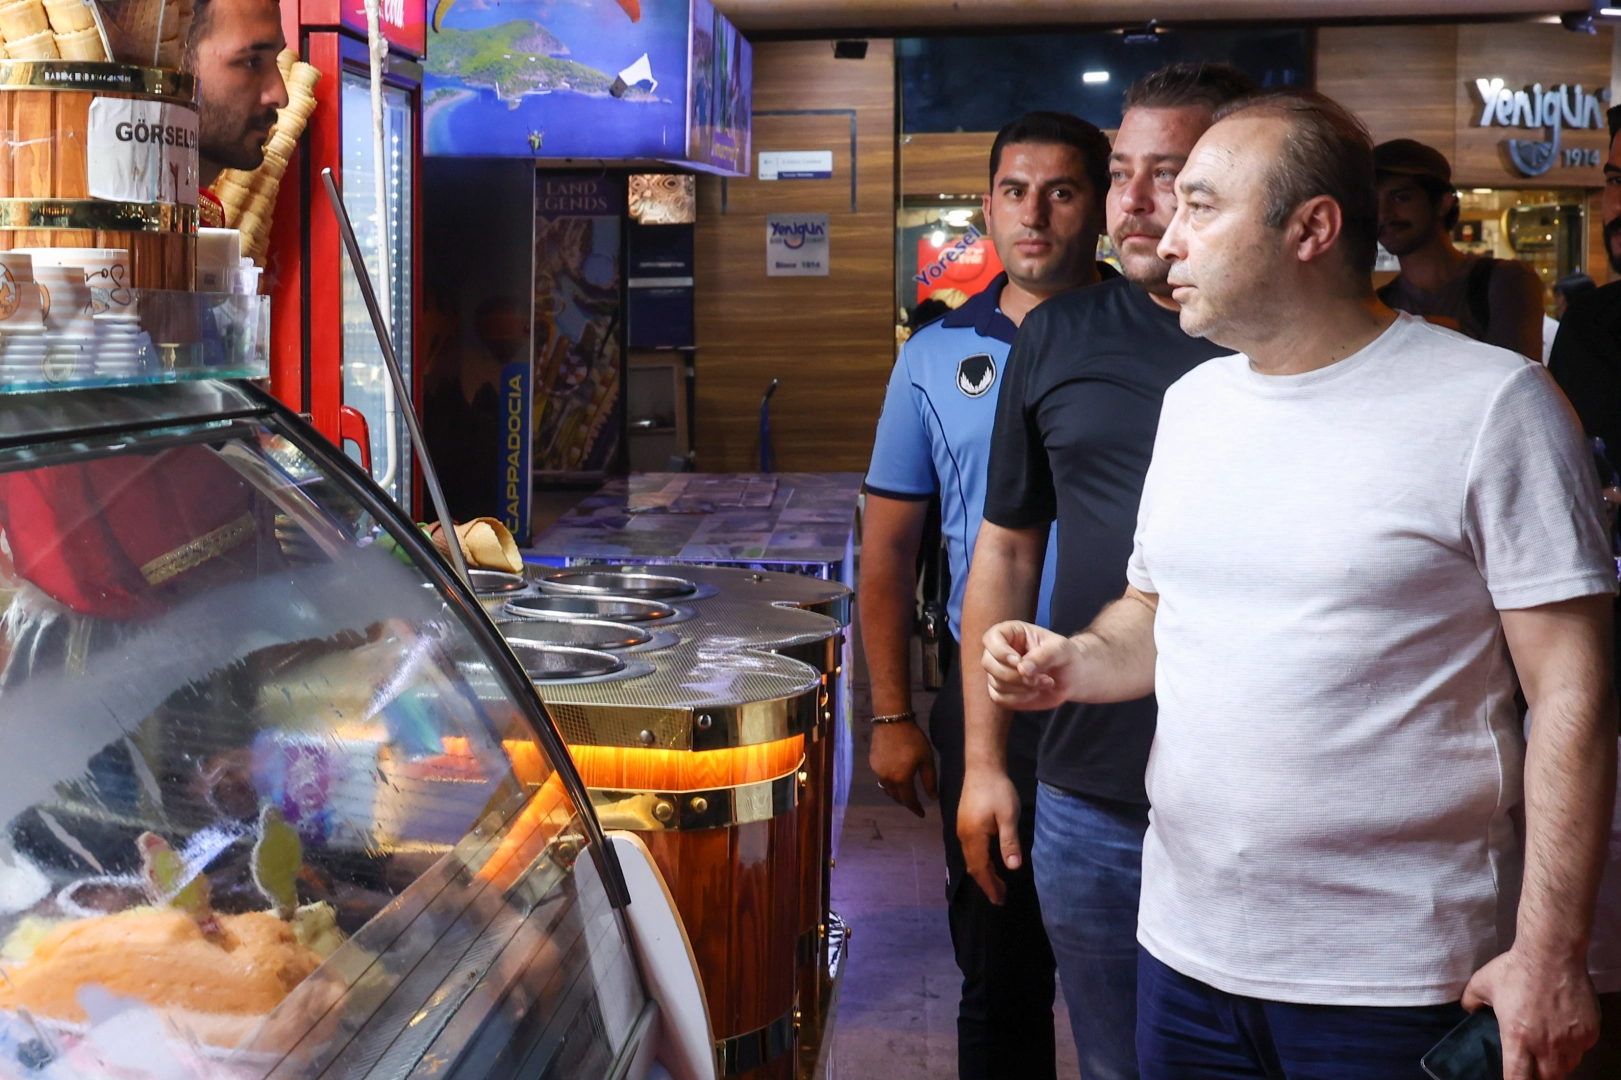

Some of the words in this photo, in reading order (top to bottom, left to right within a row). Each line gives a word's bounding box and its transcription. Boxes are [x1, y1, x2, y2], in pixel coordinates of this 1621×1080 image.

[1565, 149, 1601, 167] 1914
[546, 181, 598, 195] LAND
[535, 196, 608, 211] EGENDS
[914, 225, 982, 287] Yöresel
[506, 374, 522, 534] CAPPADOCIA
